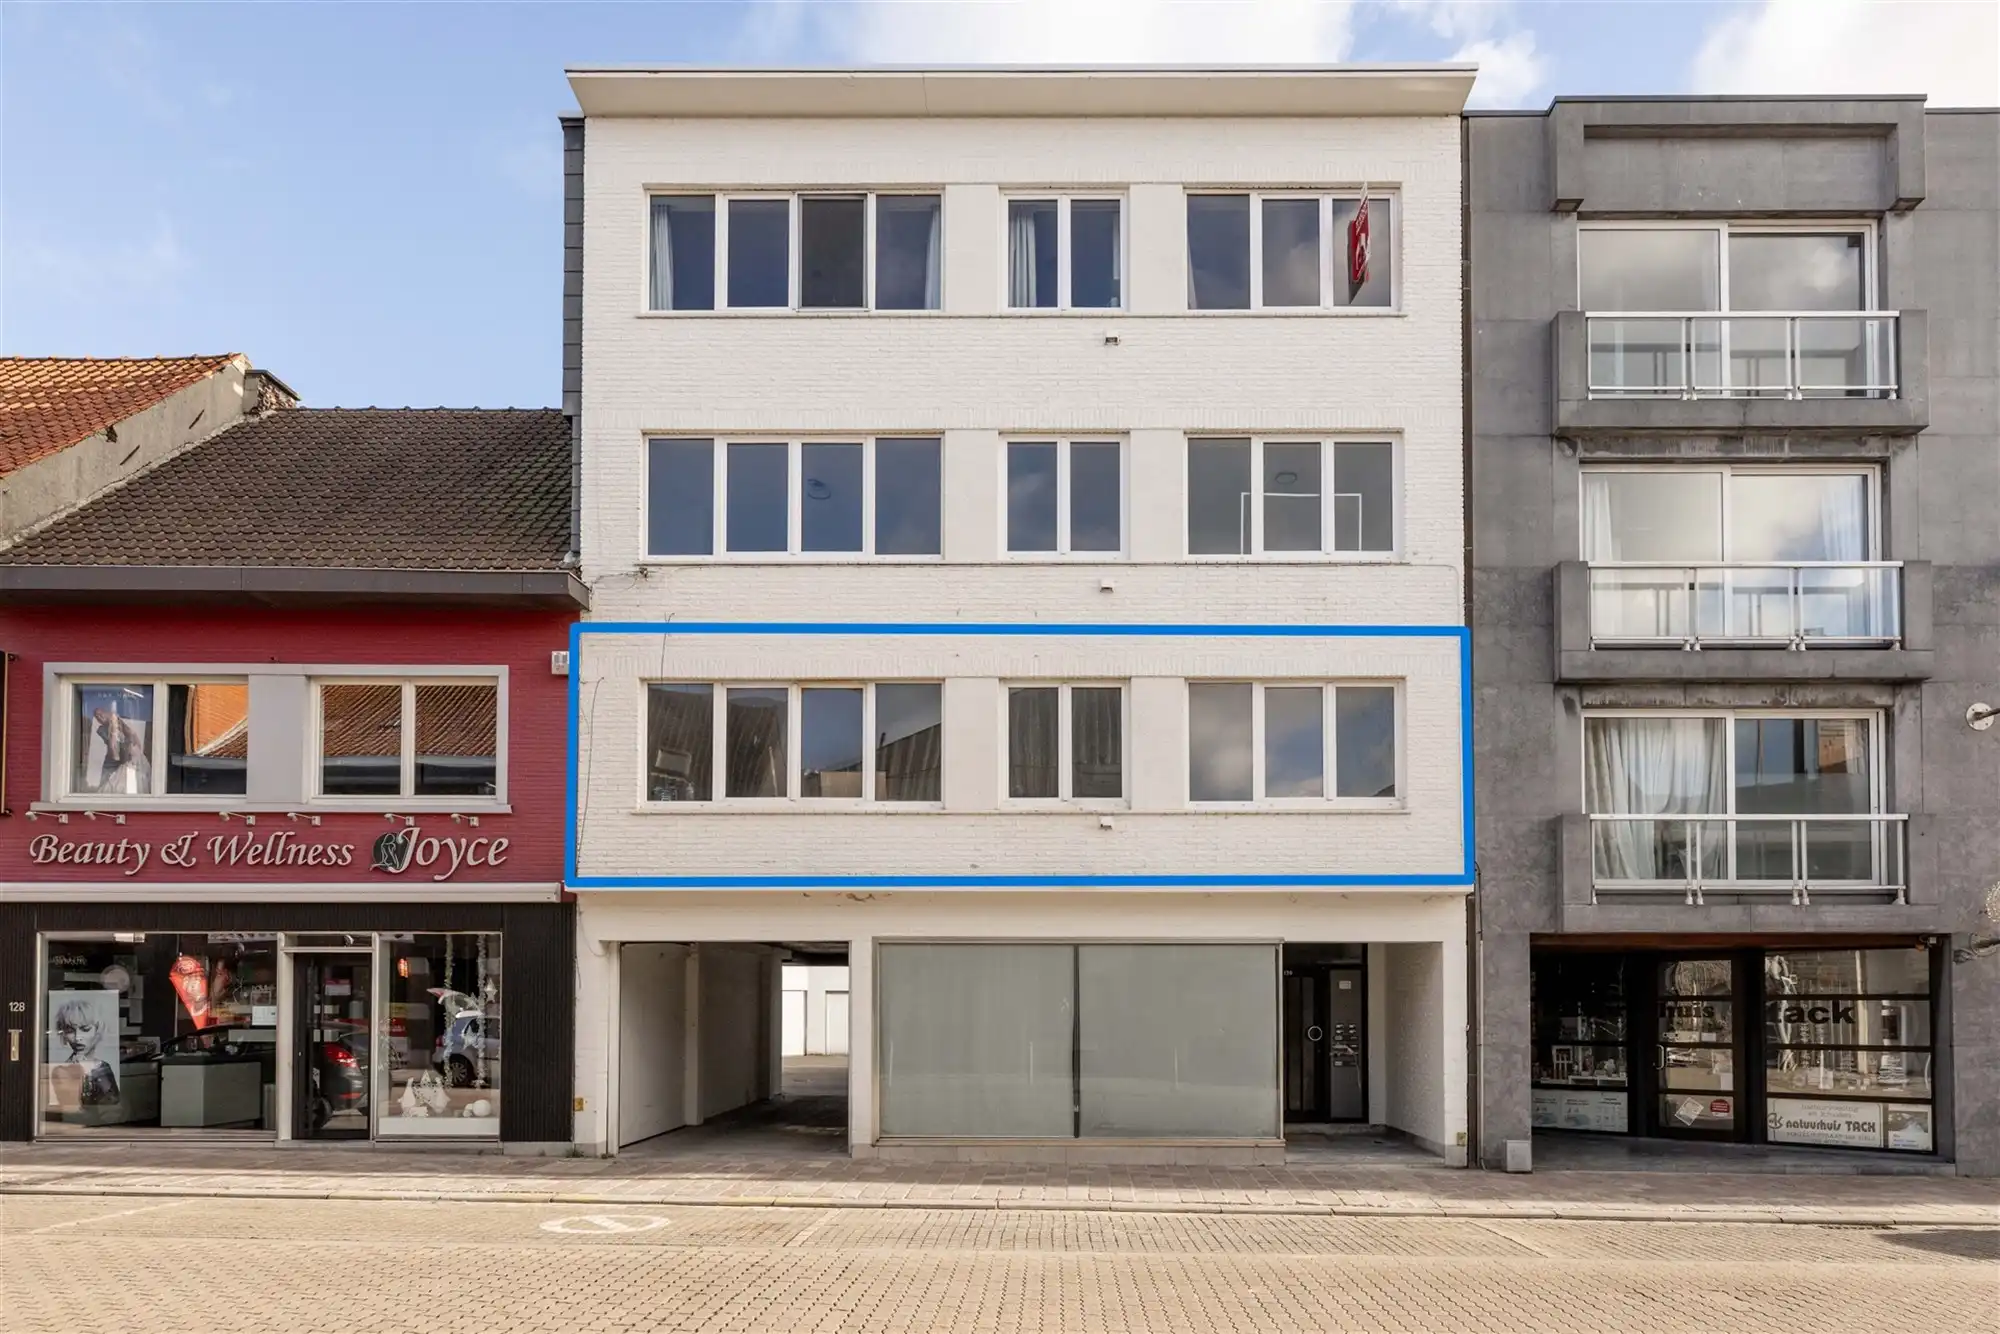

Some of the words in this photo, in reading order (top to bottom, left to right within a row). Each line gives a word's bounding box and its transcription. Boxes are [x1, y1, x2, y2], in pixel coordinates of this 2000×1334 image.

[29, 832, 151, 875] Beauty
[160, 830, 198, 868] &
[206, 831, 355, 866] Wellness
[387, 827, 509, 881] Joyce
[8, 1001, 26, 1012] 128
